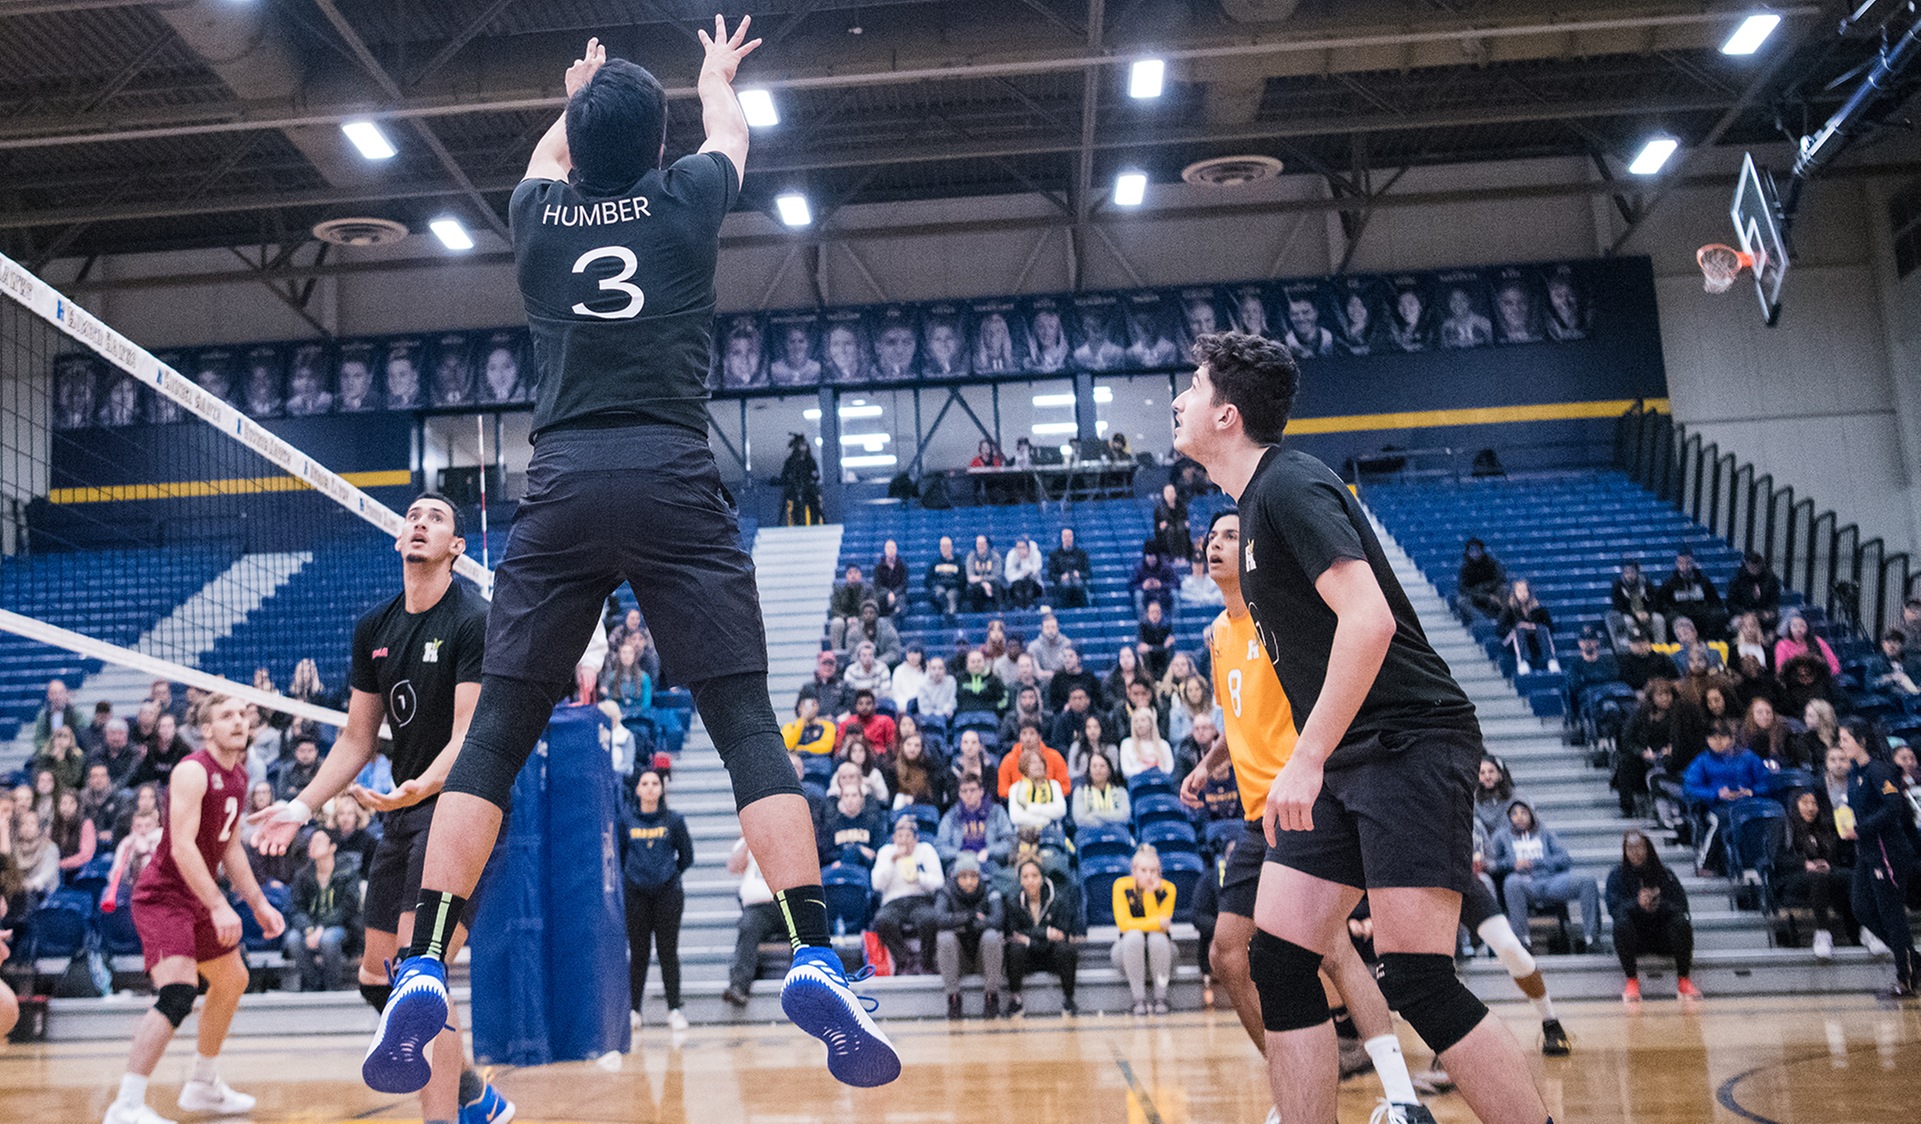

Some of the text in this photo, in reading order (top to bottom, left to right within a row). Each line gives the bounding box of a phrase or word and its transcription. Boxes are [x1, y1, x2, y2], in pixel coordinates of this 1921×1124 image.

[542, 196, 651, 227] HUMBER
[571, 245, 645, 319] 3
[398, 694, 406, 710] 1
[1227, 669, 1243, 719] 8
[218, 796, 238, 842] 2
